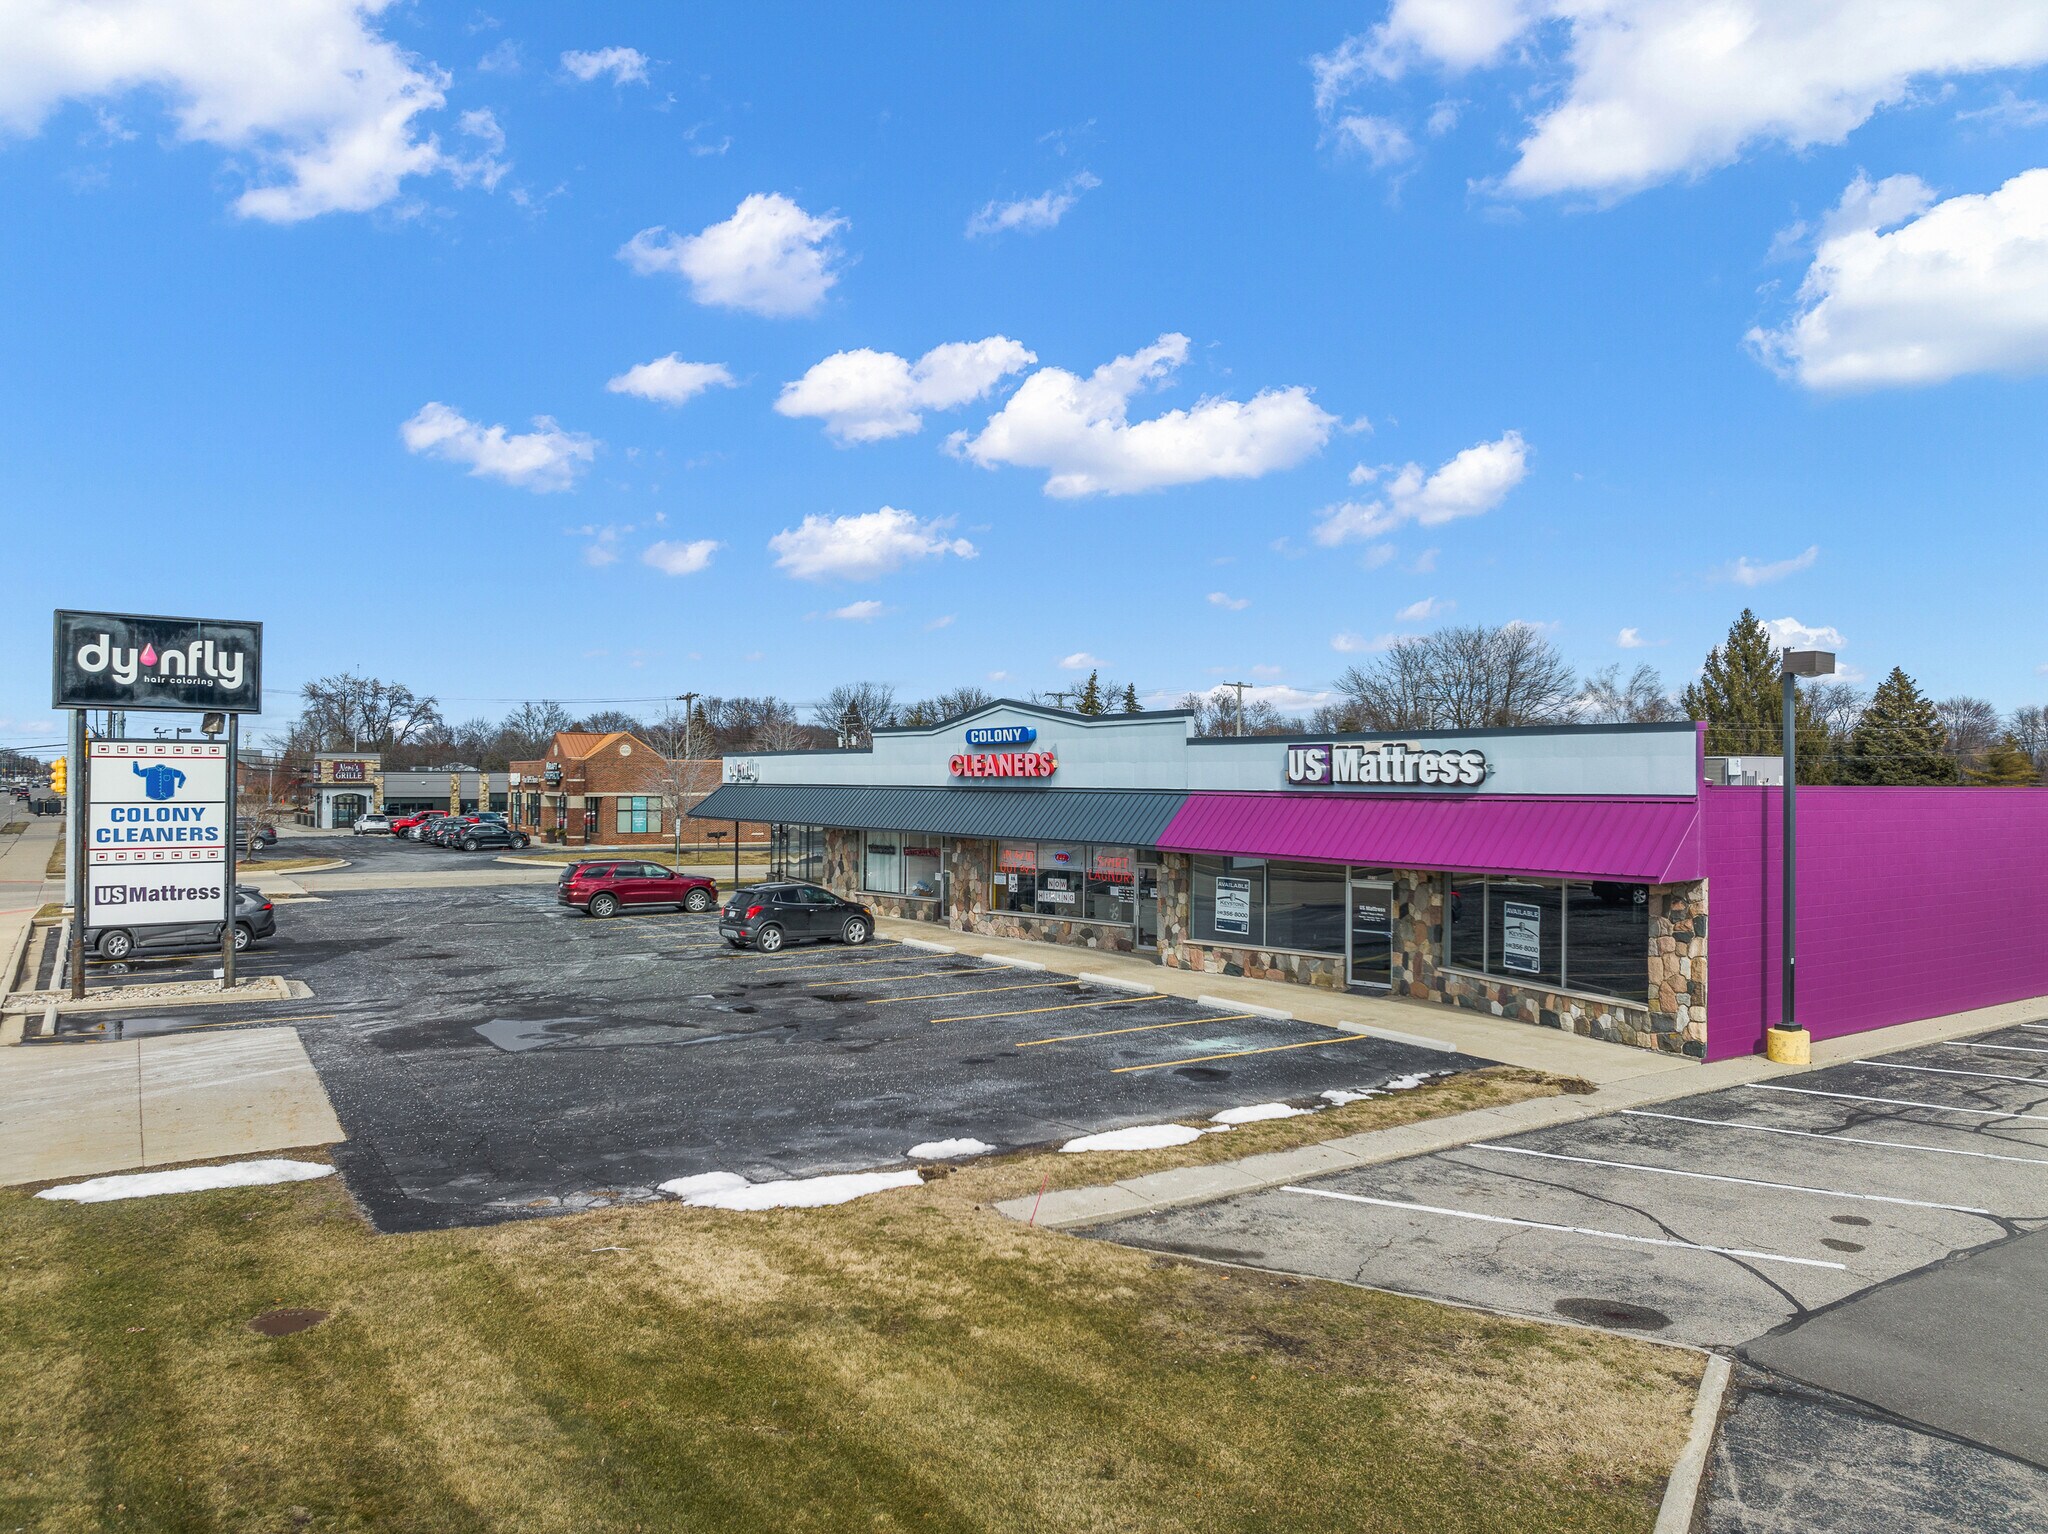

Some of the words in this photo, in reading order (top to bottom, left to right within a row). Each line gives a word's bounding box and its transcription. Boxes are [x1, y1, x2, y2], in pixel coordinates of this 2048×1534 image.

[144, 676, 166, 684] hair
[169, 677, 214, 687] coloring
[970, 729, 1022, 742] COLONY
[948, 752, 1053, 777] CLEANERS
[1288, 748, 1326, 781] US
[1331, 746, 1485, 785] Mattress
[335, 770, 363, 780] GRILLE
[110, 807, 206, 822] COLONY
[96, 826, 219, 843] CLEANERS
[1097, 855, 1130, 869] SHIRT
[1048, 880, 1067, 888] NOW
[1218, 881, 1249, 889] AVAILABLE
[97, 886, 125, 904] US
[129, 885, 221, 902] Mattress
[1038, 892, 1074, 901] HIRING
[1506, 908, 1539, 918] AVAILABLE
